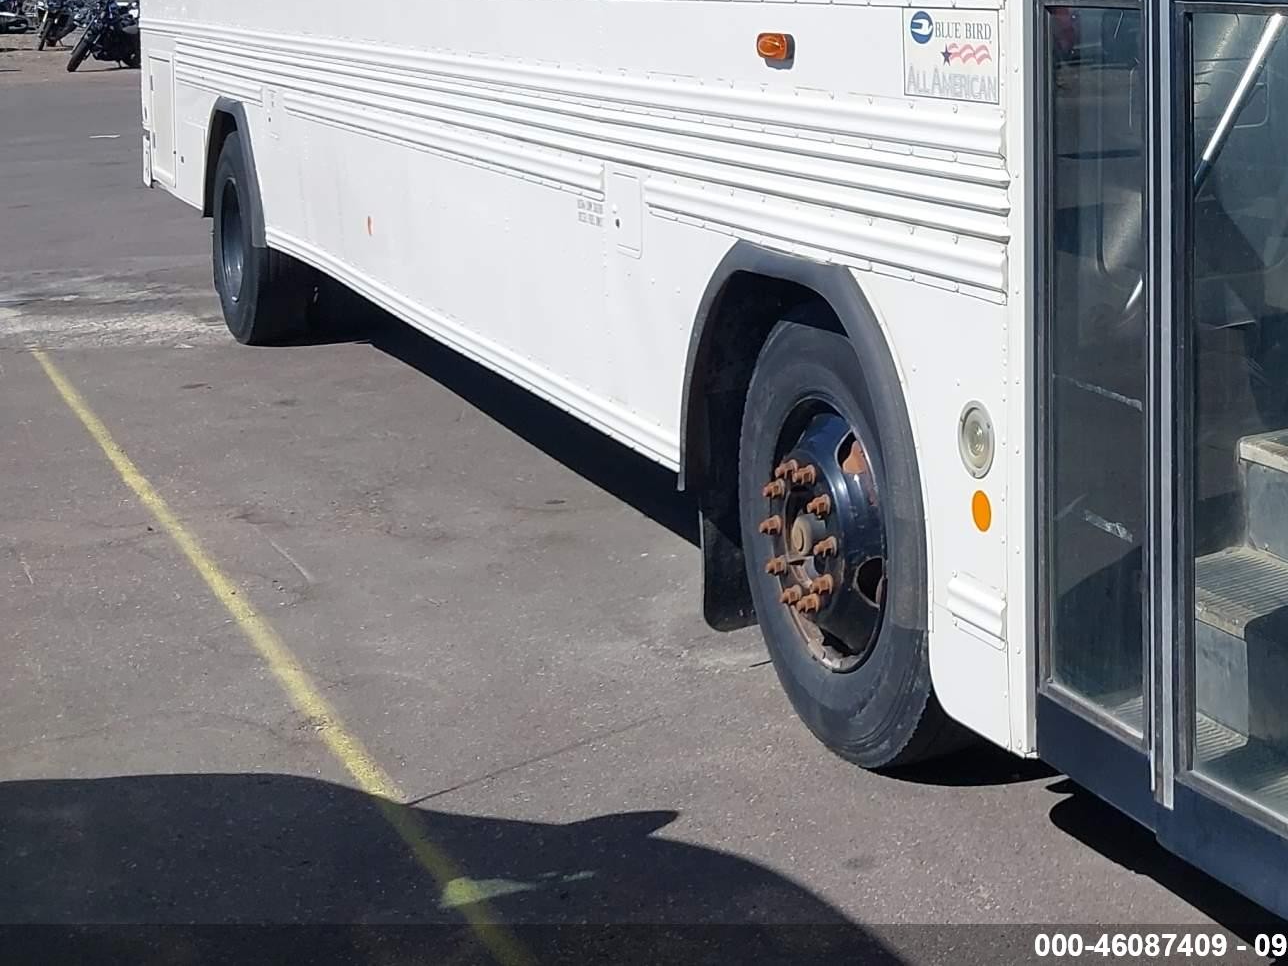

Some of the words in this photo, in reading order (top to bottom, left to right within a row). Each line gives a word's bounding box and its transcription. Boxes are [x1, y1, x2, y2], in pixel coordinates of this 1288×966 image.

[935, 21, 962, 39] BLUE
[965, 22, 992, 41] BIRD
[907, 65, 930, 94] ALL
[931, 67, 997, 102] AMERICAN
